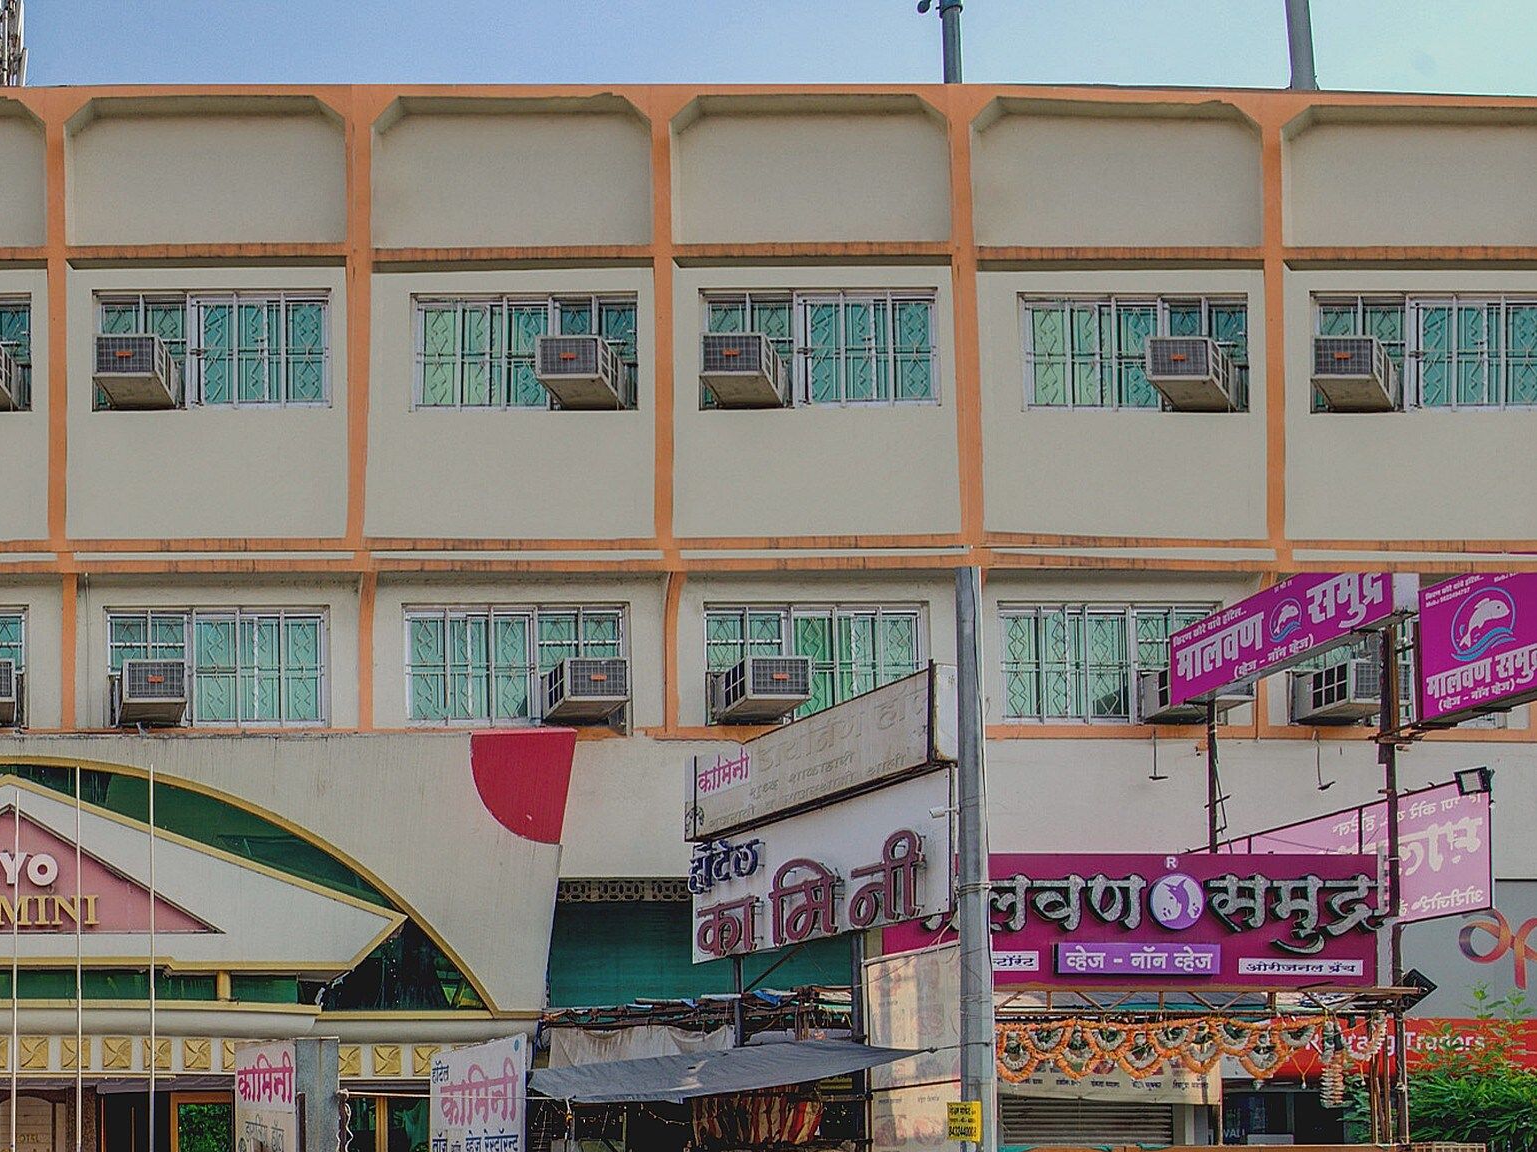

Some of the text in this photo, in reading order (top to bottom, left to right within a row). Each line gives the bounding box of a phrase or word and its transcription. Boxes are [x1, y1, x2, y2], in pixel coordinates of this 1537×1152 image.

[1176, 611, 1264, 681] मालवण
[1426, 656, 1492, 699] मालवण
[698, 748, 750, 793] कामिनी
[1207, 873, 1383, 953] समुद्र
[1065, 945, 1106, 971] व्हेज
[1131, 946, 1168, 969] नॉन
[1174, 946, 1213, 972] व्हेज
[238, 1051, 293, 1104] कामिनी
[440, 1056, 519, 1125] कामिनी
